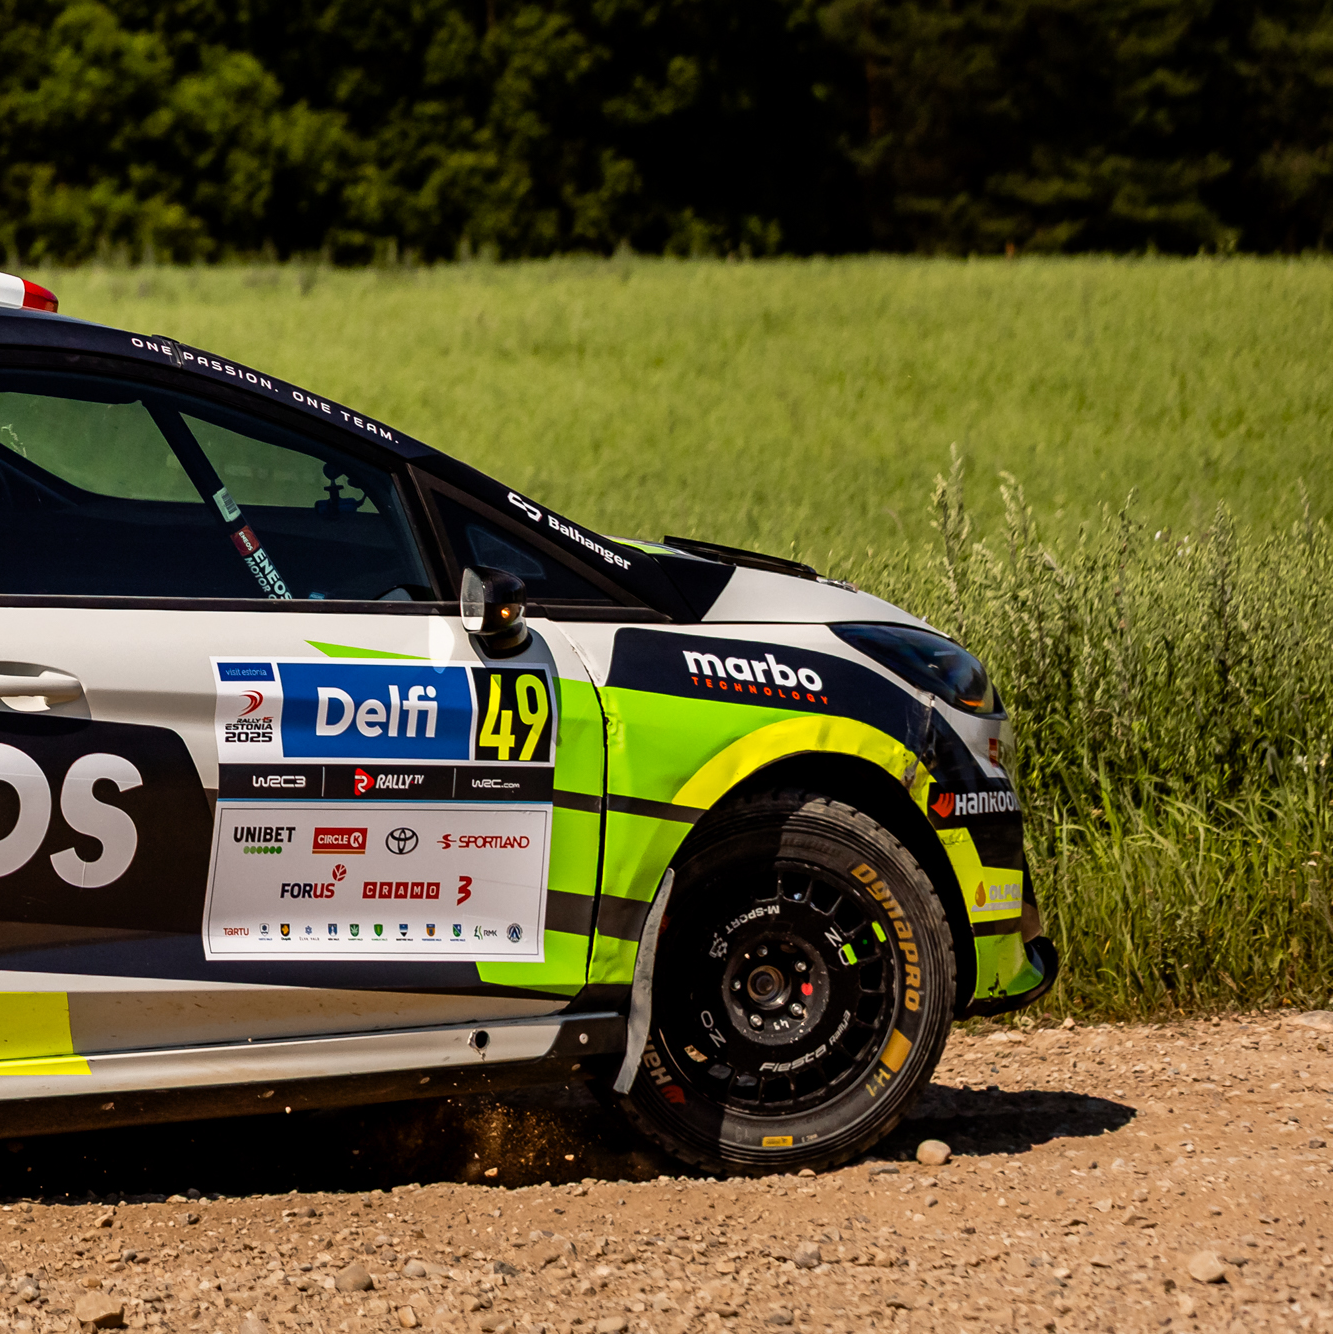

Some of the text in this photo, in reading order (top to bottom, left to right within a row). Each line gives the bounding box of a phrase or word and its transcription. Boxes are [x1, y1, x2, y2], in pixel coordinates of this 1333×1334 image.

[131, 337, 400, 445] ONE PASSION. ONE TEAM.
[238, 531, 254, 552] ENEOS
[547, 515, 632, 571] Balhanger
[244, 556, 272, 593] MOTOR
[225, 667, 268, 676] visit estonia
[683, 650, 824, 692] marbo
[690, 676, 829, 705] TECHNOLOGY
[315, 685, 438, 738] Delfi
[478, 674, 549, 761] 49
[225, 723, 273, 731] ESTONIA
[225, 731, 273, 743] 2025
[252, 775, 306, 788] WRC3
[471, 778, 521, 789] WRC.com
[233, 826, 296, 843] UNIBET
[317, 833, 363, 846] CIRCLE K
[458, 835, 531, 849] SPORTLAND
[280, 881, 336, 899] FORUS
[364, 884, 439, 897] CRAMO
[456, 875, 473, 907] 3
[725, 904, 781, 935] M-SPORT
[483, 929, 498, 937] RMK
